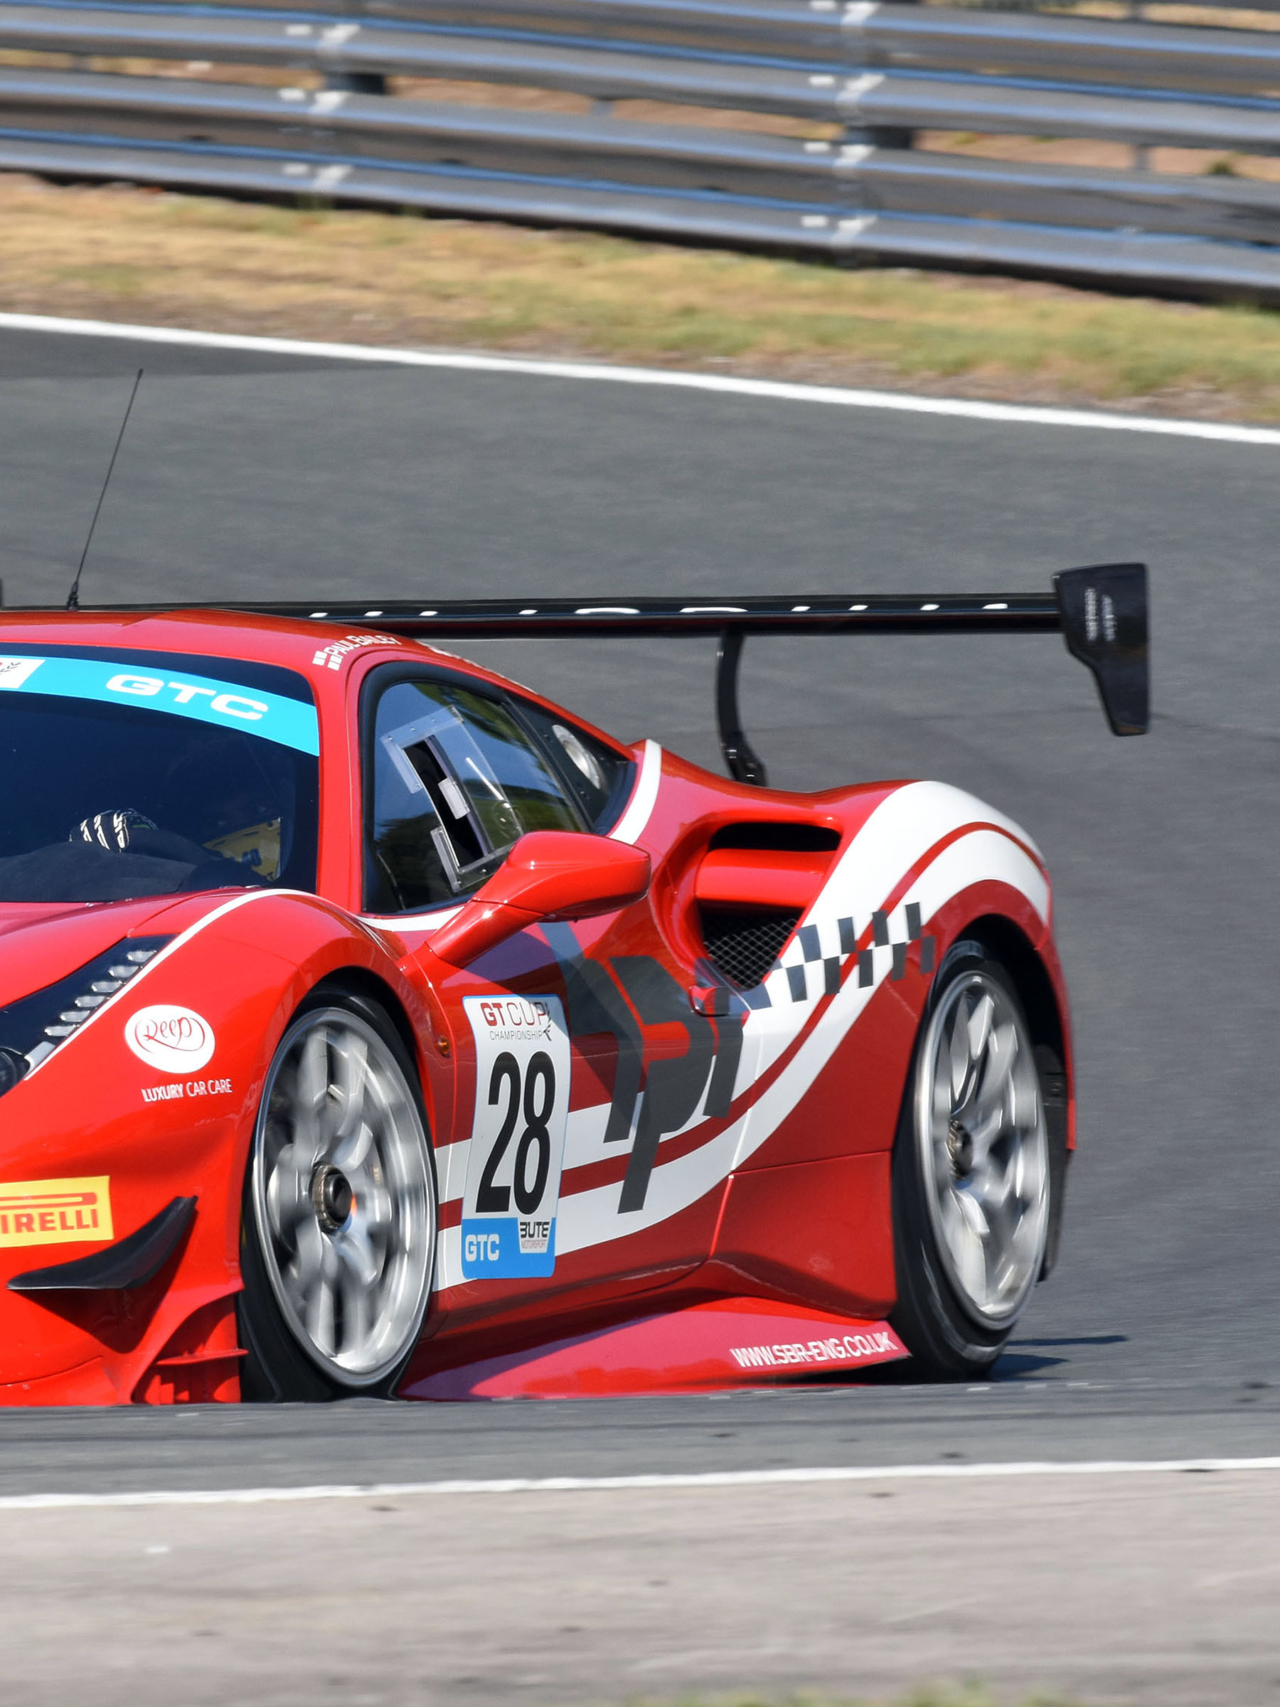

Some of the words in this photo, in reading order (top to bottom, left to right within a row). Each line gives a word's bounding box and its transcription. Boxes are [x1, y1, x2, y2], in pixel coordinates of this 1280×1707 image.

[105, 674, 269, 721] GTC
[480, 1002, 506, 1026] GT
[506, 1002, 547, 1026] CUP
[489, 1029, 543, 1041] CHAMPIONSHIP
[141, 1083, 184, 1102] LUXURY
[186, 1081, 208, 1097] CAR
[207, 1078, 233, 1095] CARE
[475, 1050, 556, 1215] 28
[519, 1221, 550, 1239] BUTE
[465, 1233, 500, 1262] GTC
